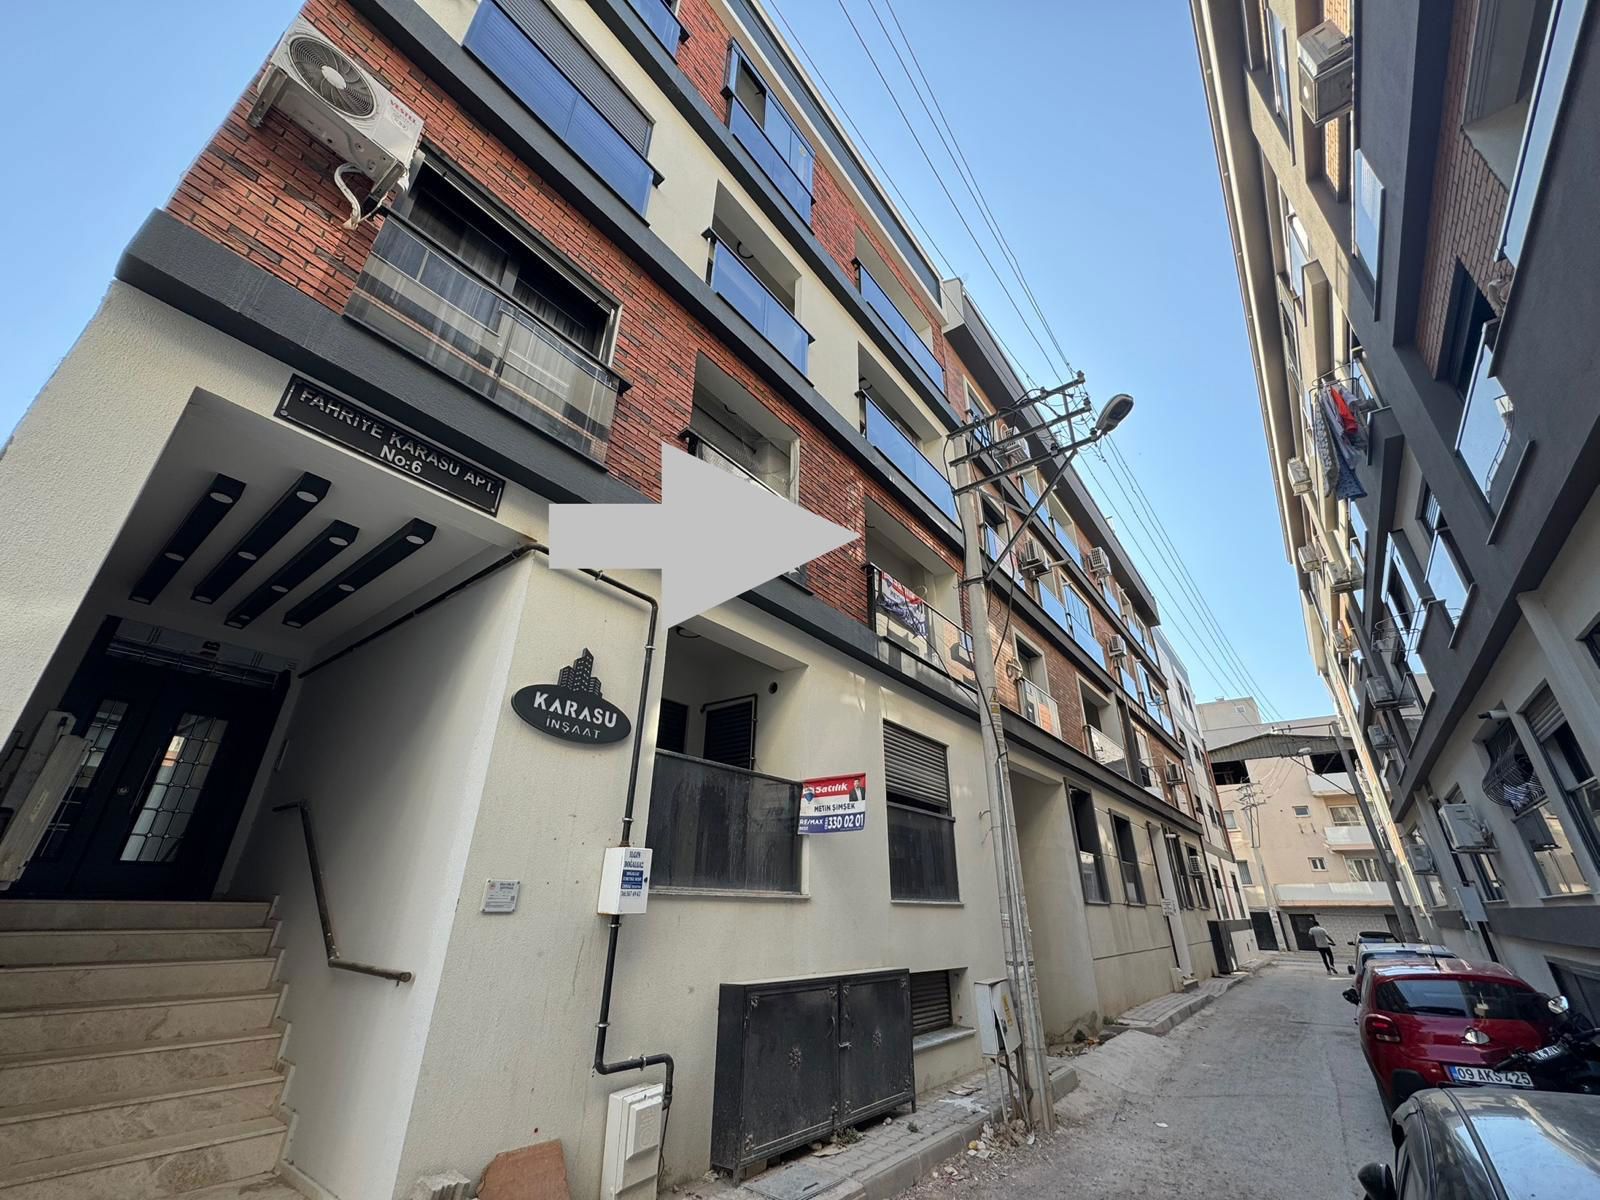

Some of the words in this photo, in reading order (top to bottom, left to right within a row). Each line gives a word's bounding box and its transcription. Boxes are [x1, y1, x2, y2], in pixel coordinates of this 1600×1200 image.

[379, 444, 423, 475] No:6
[389, 430, 460, 476] KARASU
[533, 691, 617, 728] KARASU
[546, 715, 600, 739] İNŞAAT
[843, 814, 854, 828] 02
[855, 813, 864, 827] 01
[1457, 1067, 1475, 1080] 09
[1478, 1069, 1502, 1083] AKS
[1505, 1072, 1530, 1085] 425
